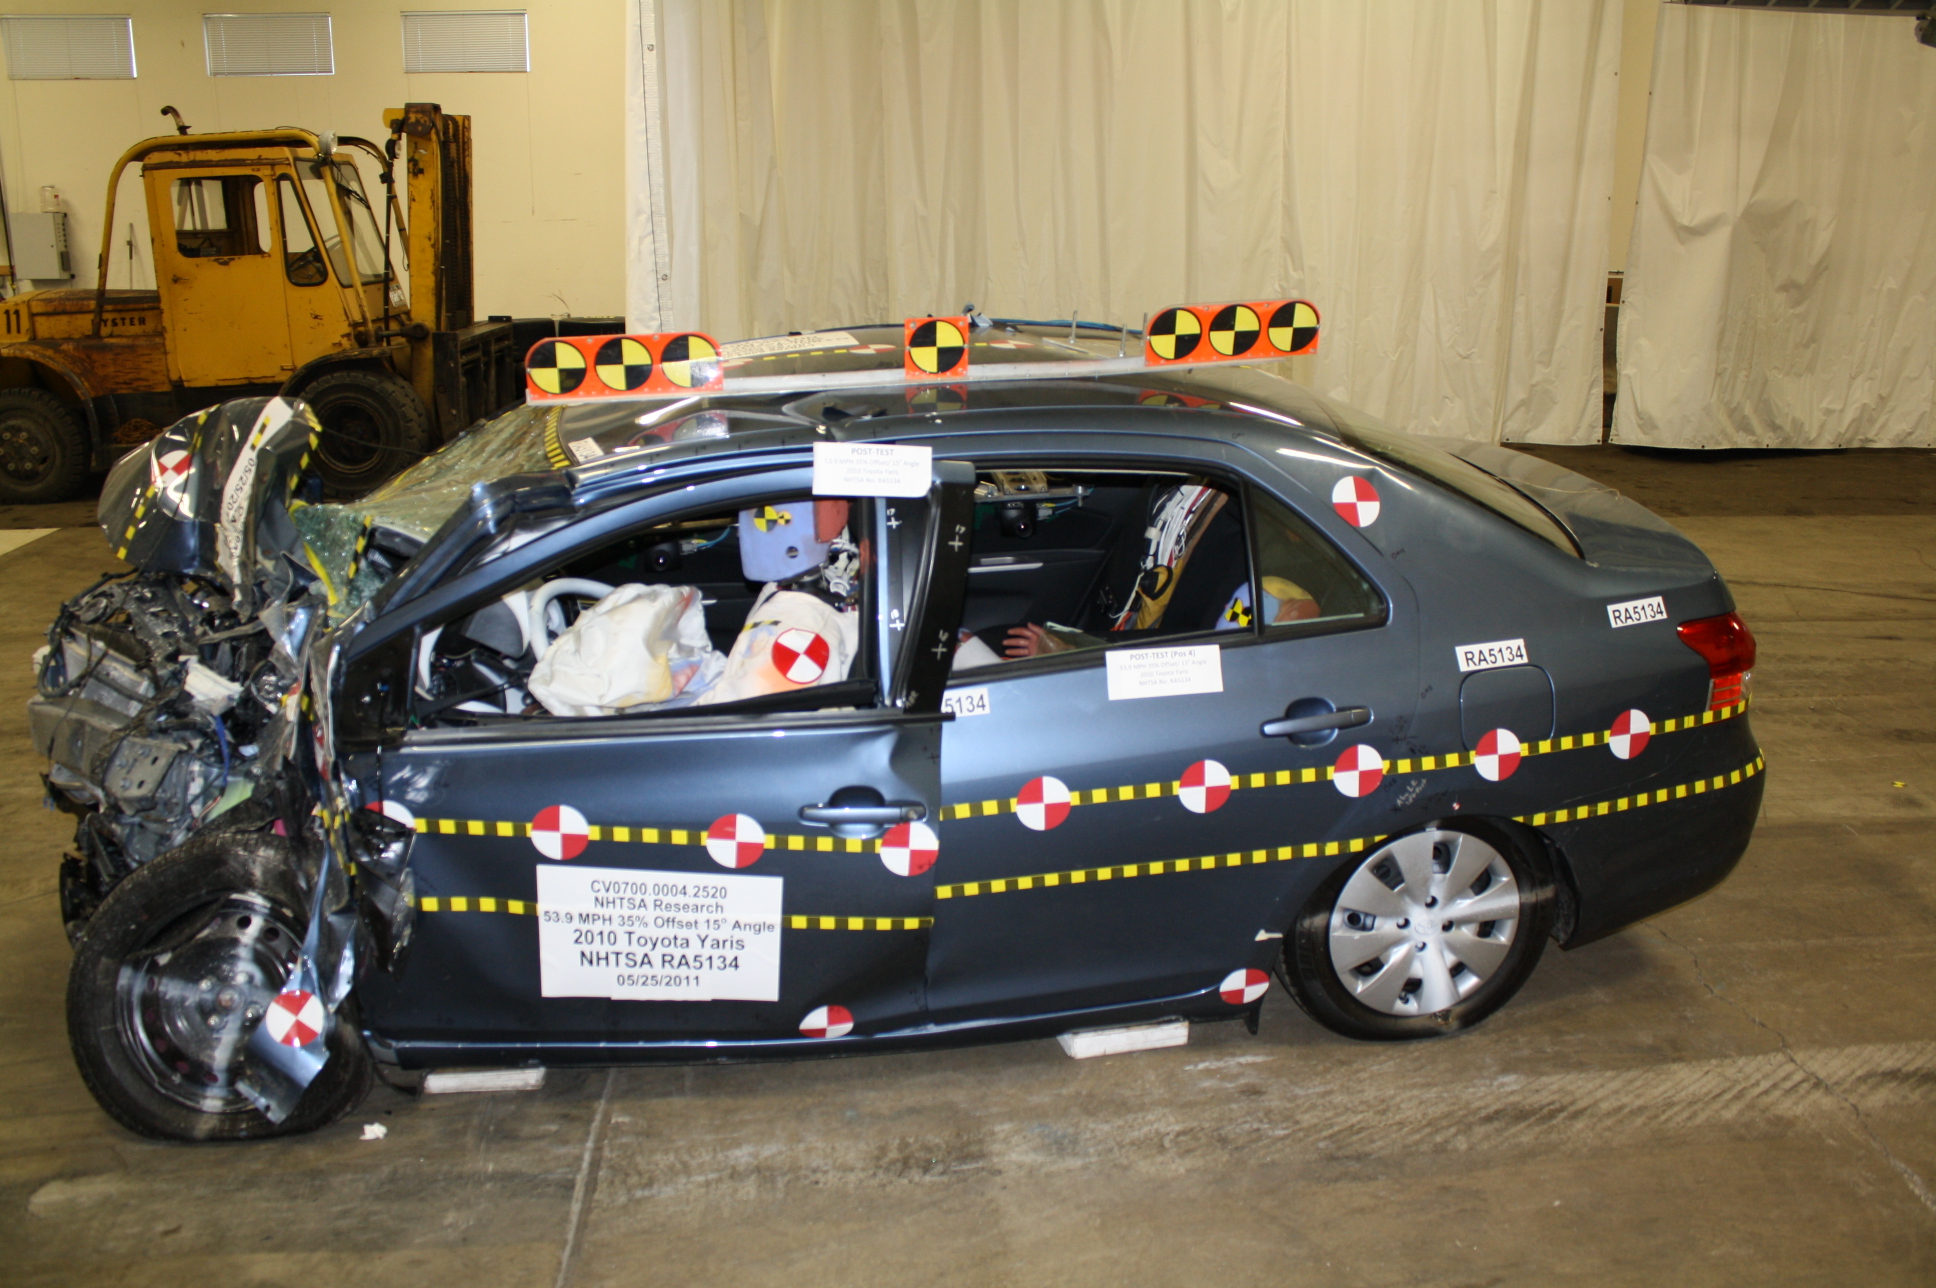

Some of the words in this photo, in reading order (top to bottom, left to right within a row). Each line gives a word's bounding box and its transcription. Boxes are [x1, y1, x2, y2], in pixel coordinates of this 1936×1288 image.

[4, 309, 21, 334] 11
[92, 317, 146, 327] YSTER
[851, 447, 895, 456] POST-TEST
[1612, 601, 1664, 625] RA5134
[1130, 651, 1169, 661] POST-TEST
[1171, 649, 1187, 659] (Pos
[1188, 649, 1196, 658] 4)
[1464, 645, 1524, 667] RA5134
[590, 880, 727, 899] CV0700.0004.2520
[594, 896, 648, 911] NHTSA
[653, 899, 724, 914] Research
[543, 911, 573, 923] 53.9
[578, 913, 612, 926] MPH
[618, 915, 648, 928] 35%
[653, 916, 699, 930] Offset
[705, 918, 727, 931] 15°
[732, 920, 775, 935] Angle
[573, 929, 617, 946] 2010
[624, 931, 690, 951] Toyota
[696, 934, 745, 951] Yaris
[579, 950, 653, 969] NHTSA
[661, 954, 740, 971] RA5134
[616, 974, 700, 988] 05/25/2011
